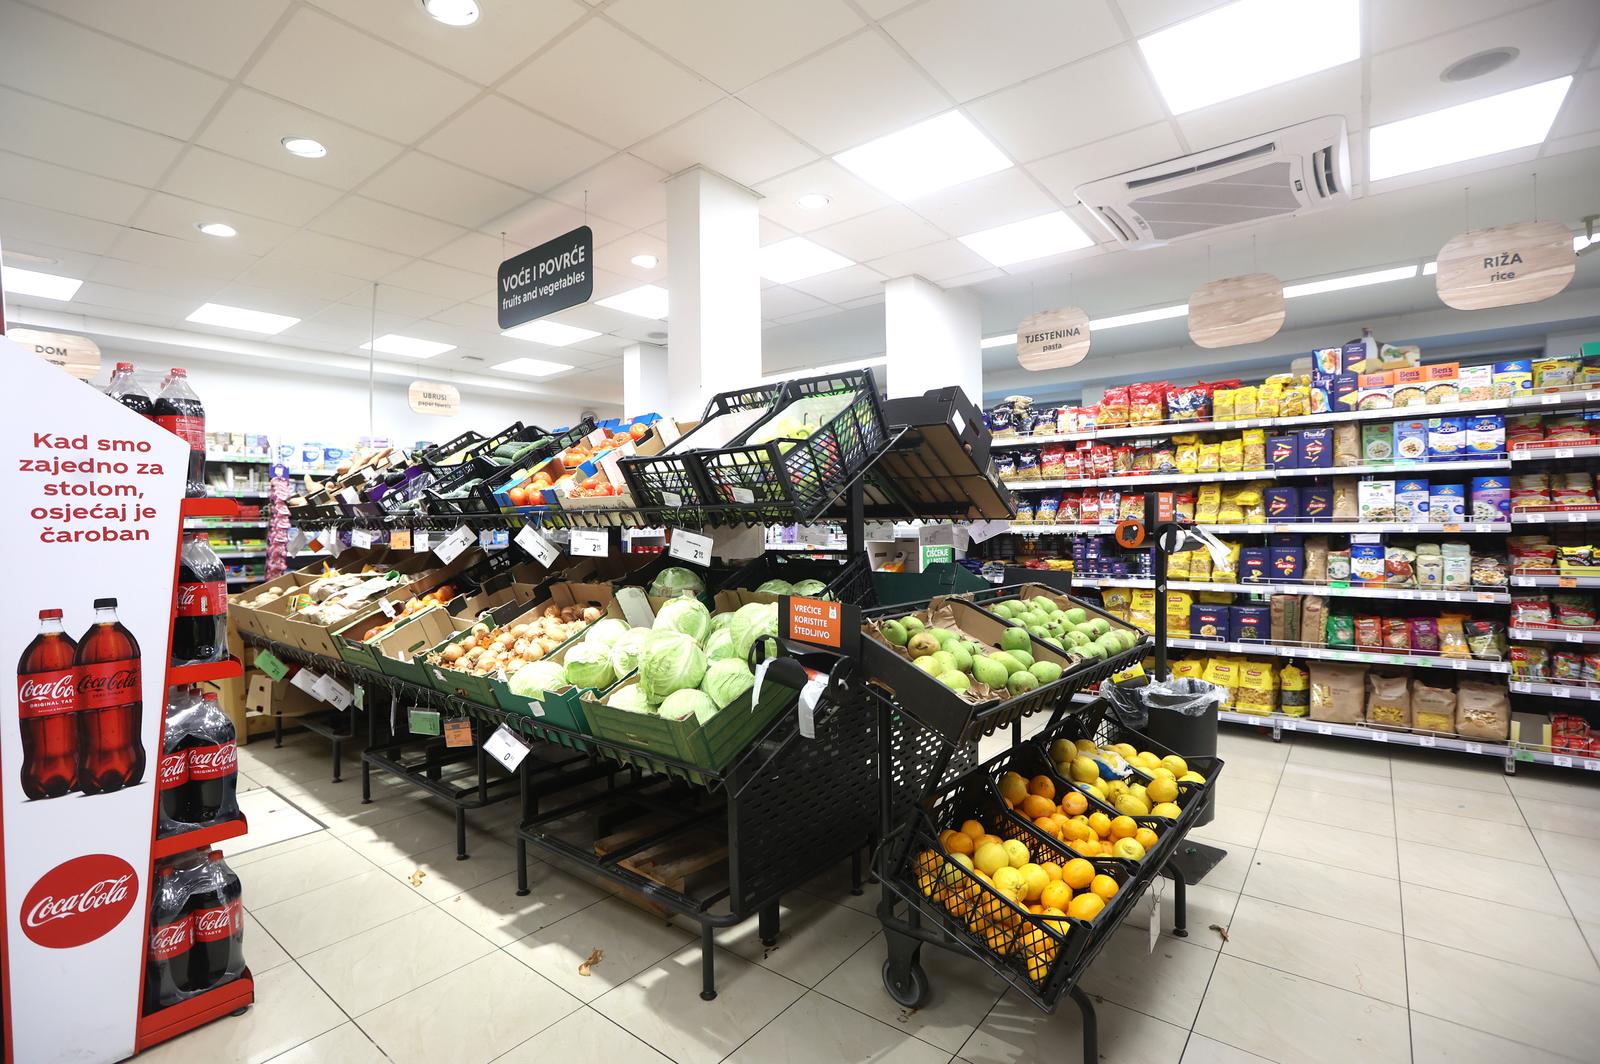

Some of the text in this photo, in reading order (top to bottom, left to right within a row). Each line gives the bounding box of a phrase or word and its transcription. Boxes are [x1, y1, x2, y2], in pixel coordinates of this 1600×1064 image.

[502, 244, 585, 292] VOĆE I POVRĆE
[1484, 252, 1523, 268] RIŽA
[1491, 272, 1515, 281] rice
[502, 271, 585, 310] fruits and vegetables
[1025, 327, 1081, 343] TJESTENINA
[35, 345, 67, 356] DOM
[1042, 343, 1062, 352] pasta
[33, 433, 151, 452] Kad smo
[19, 456, 164, 475] zajedno za
[44, 481, 144, 499] stolom,
[30, 503, 156, 522] osjećaj je
[40, 526, 149, 543] čaroban
[794, 615, 828, 627] KORISTITE
[794, 625, 830, 639] ŠTEDLJIVO
[20, 669, 138, 703] Coca-Co Coca-Cola
[27, 873, 133, 927] Coca-Cola
